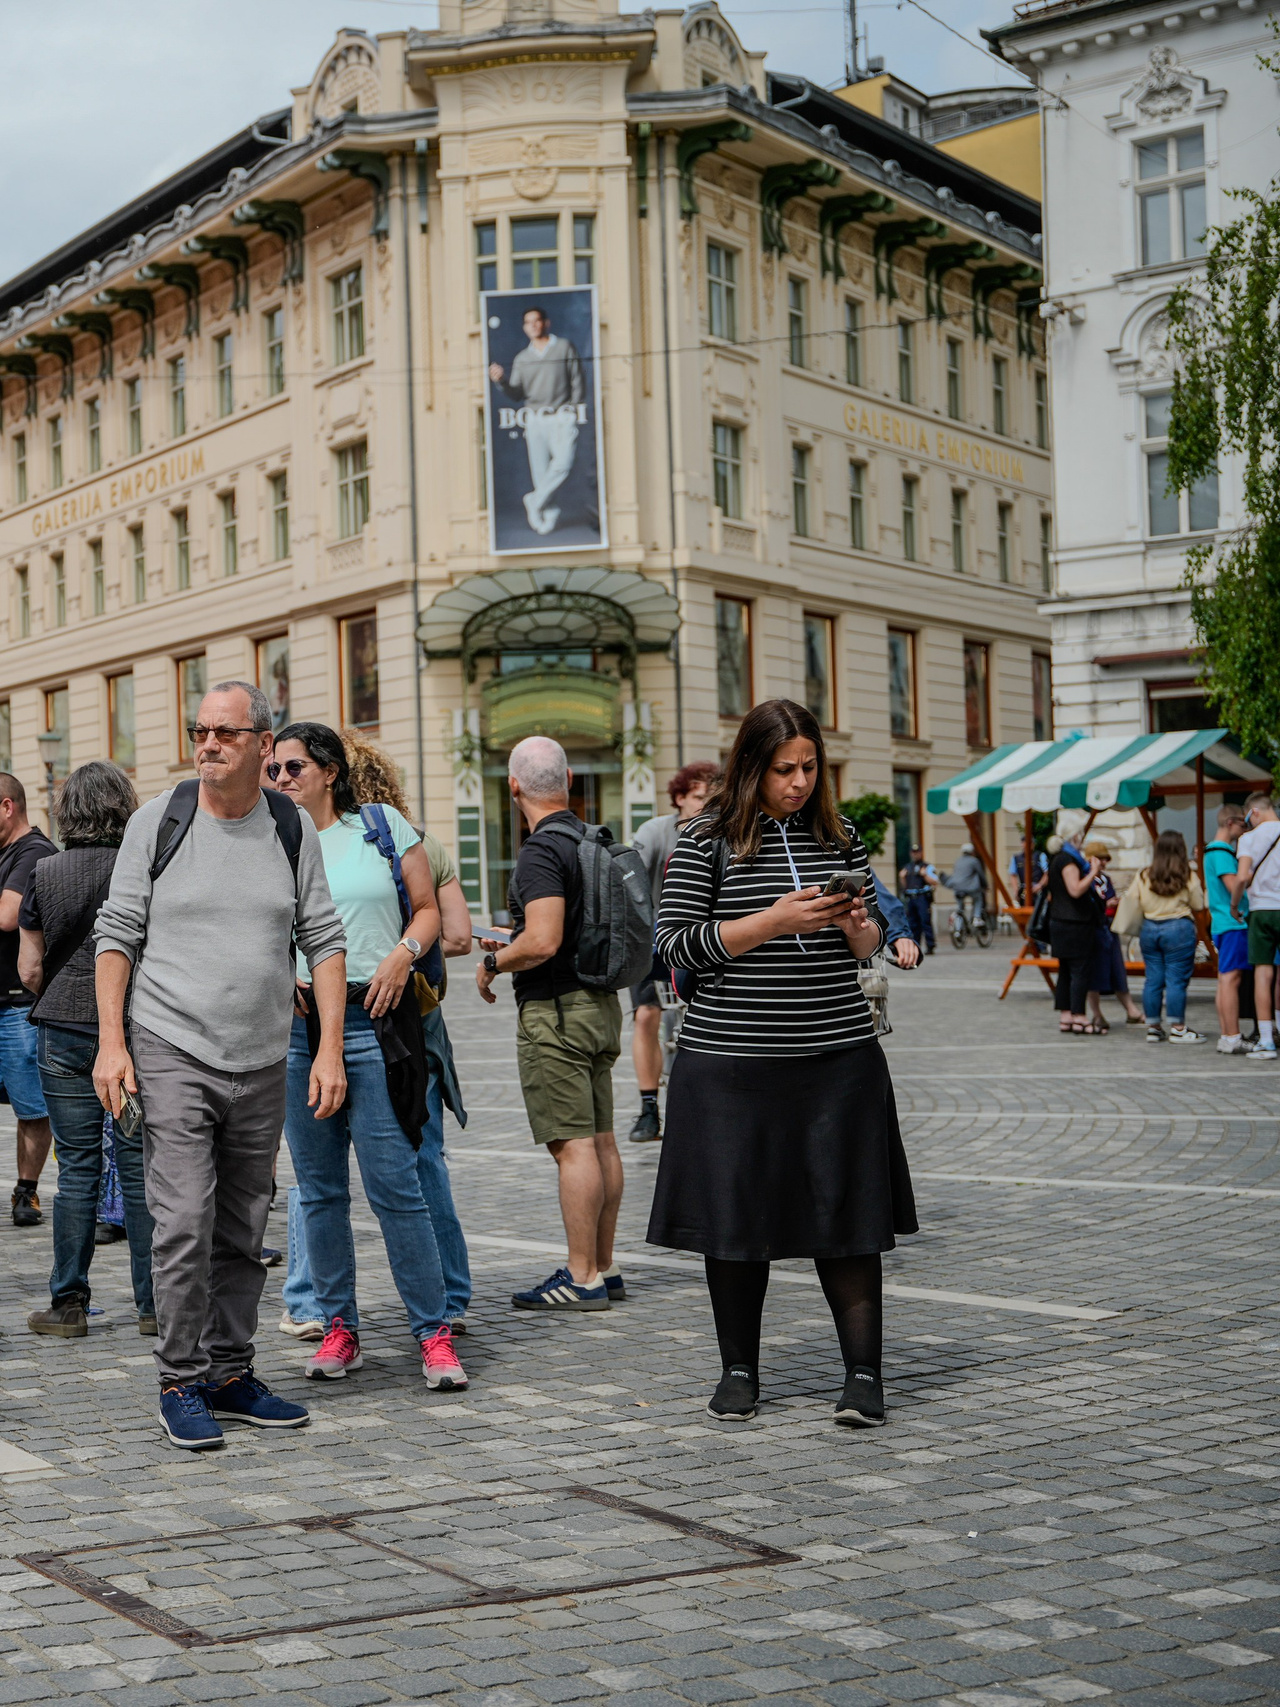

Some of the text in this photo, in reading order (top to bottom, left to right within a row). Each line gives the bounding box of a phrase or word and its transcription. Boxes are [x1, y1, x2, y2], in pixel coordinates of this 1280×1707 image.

[844, 402, 1024, 482] GALERIJA EMPORIUM
[32, 446, 205, 537] GALERIJA EMPORIUM
